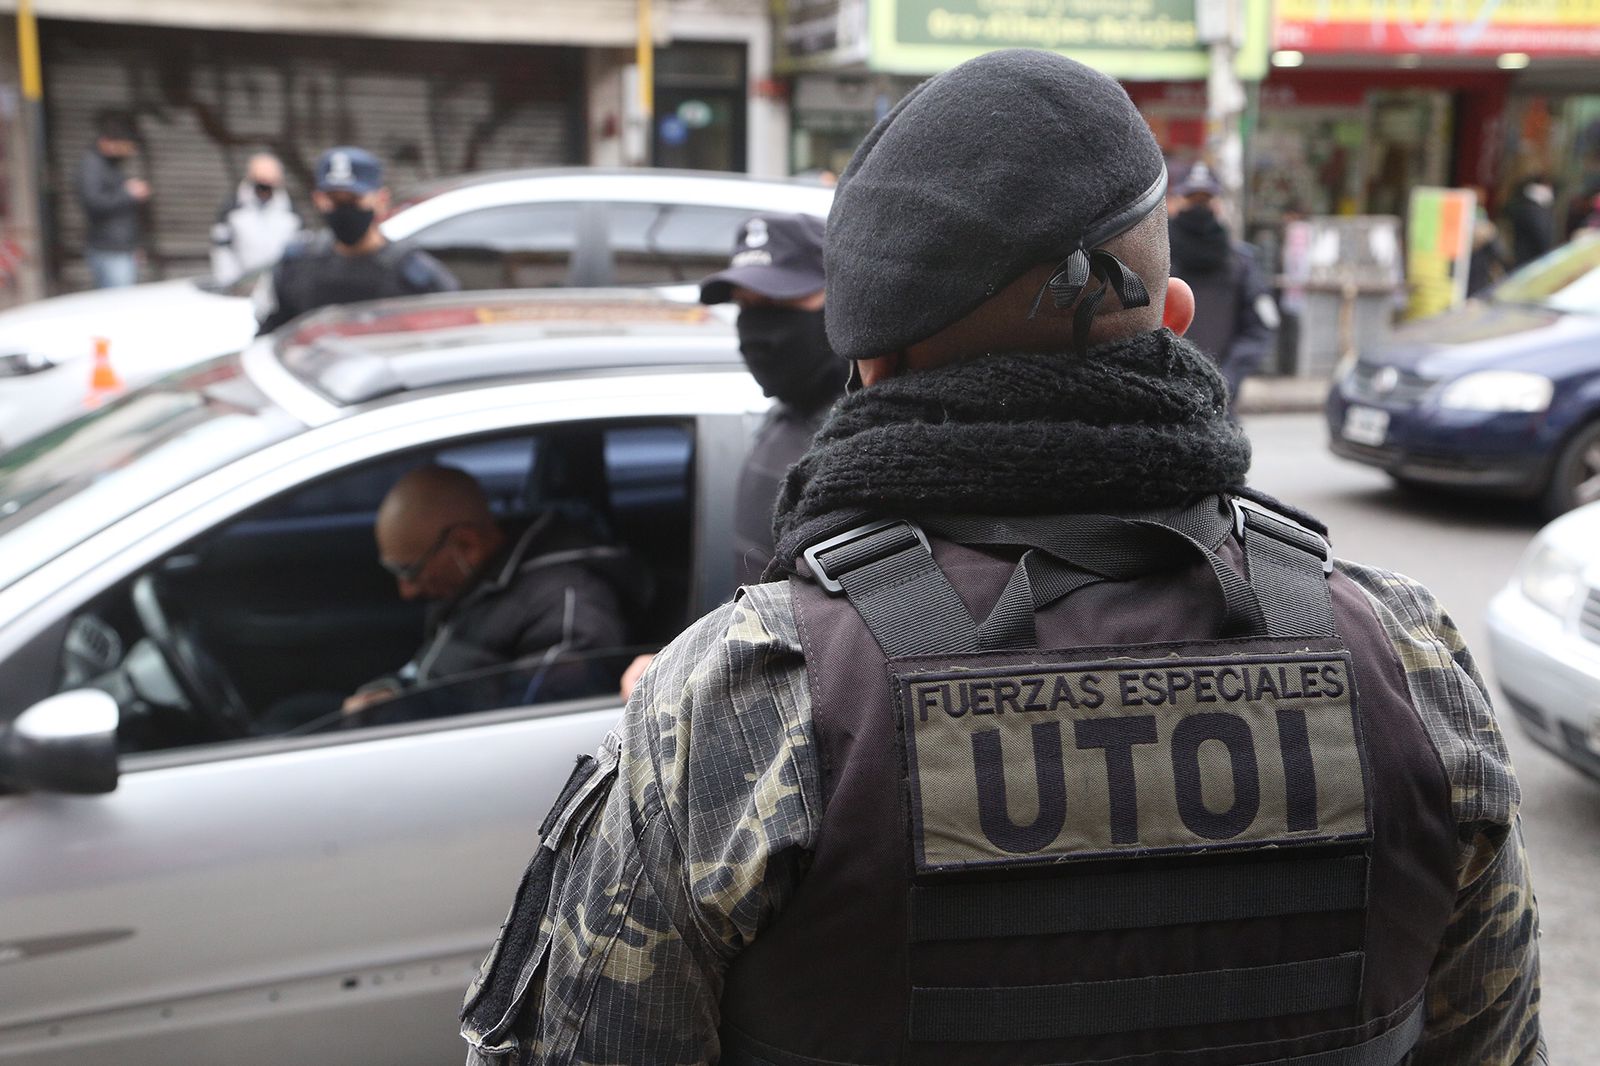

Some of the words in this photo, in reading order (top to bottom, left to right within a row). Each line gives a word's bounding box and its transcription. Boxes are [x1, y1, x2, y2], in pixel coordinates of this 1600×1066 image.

[917, 674, 1105, 722] FUERZAS
[1118, 665, 1345, 707] ESPECIALES
[970, 708, 1319, 855] UTOI
